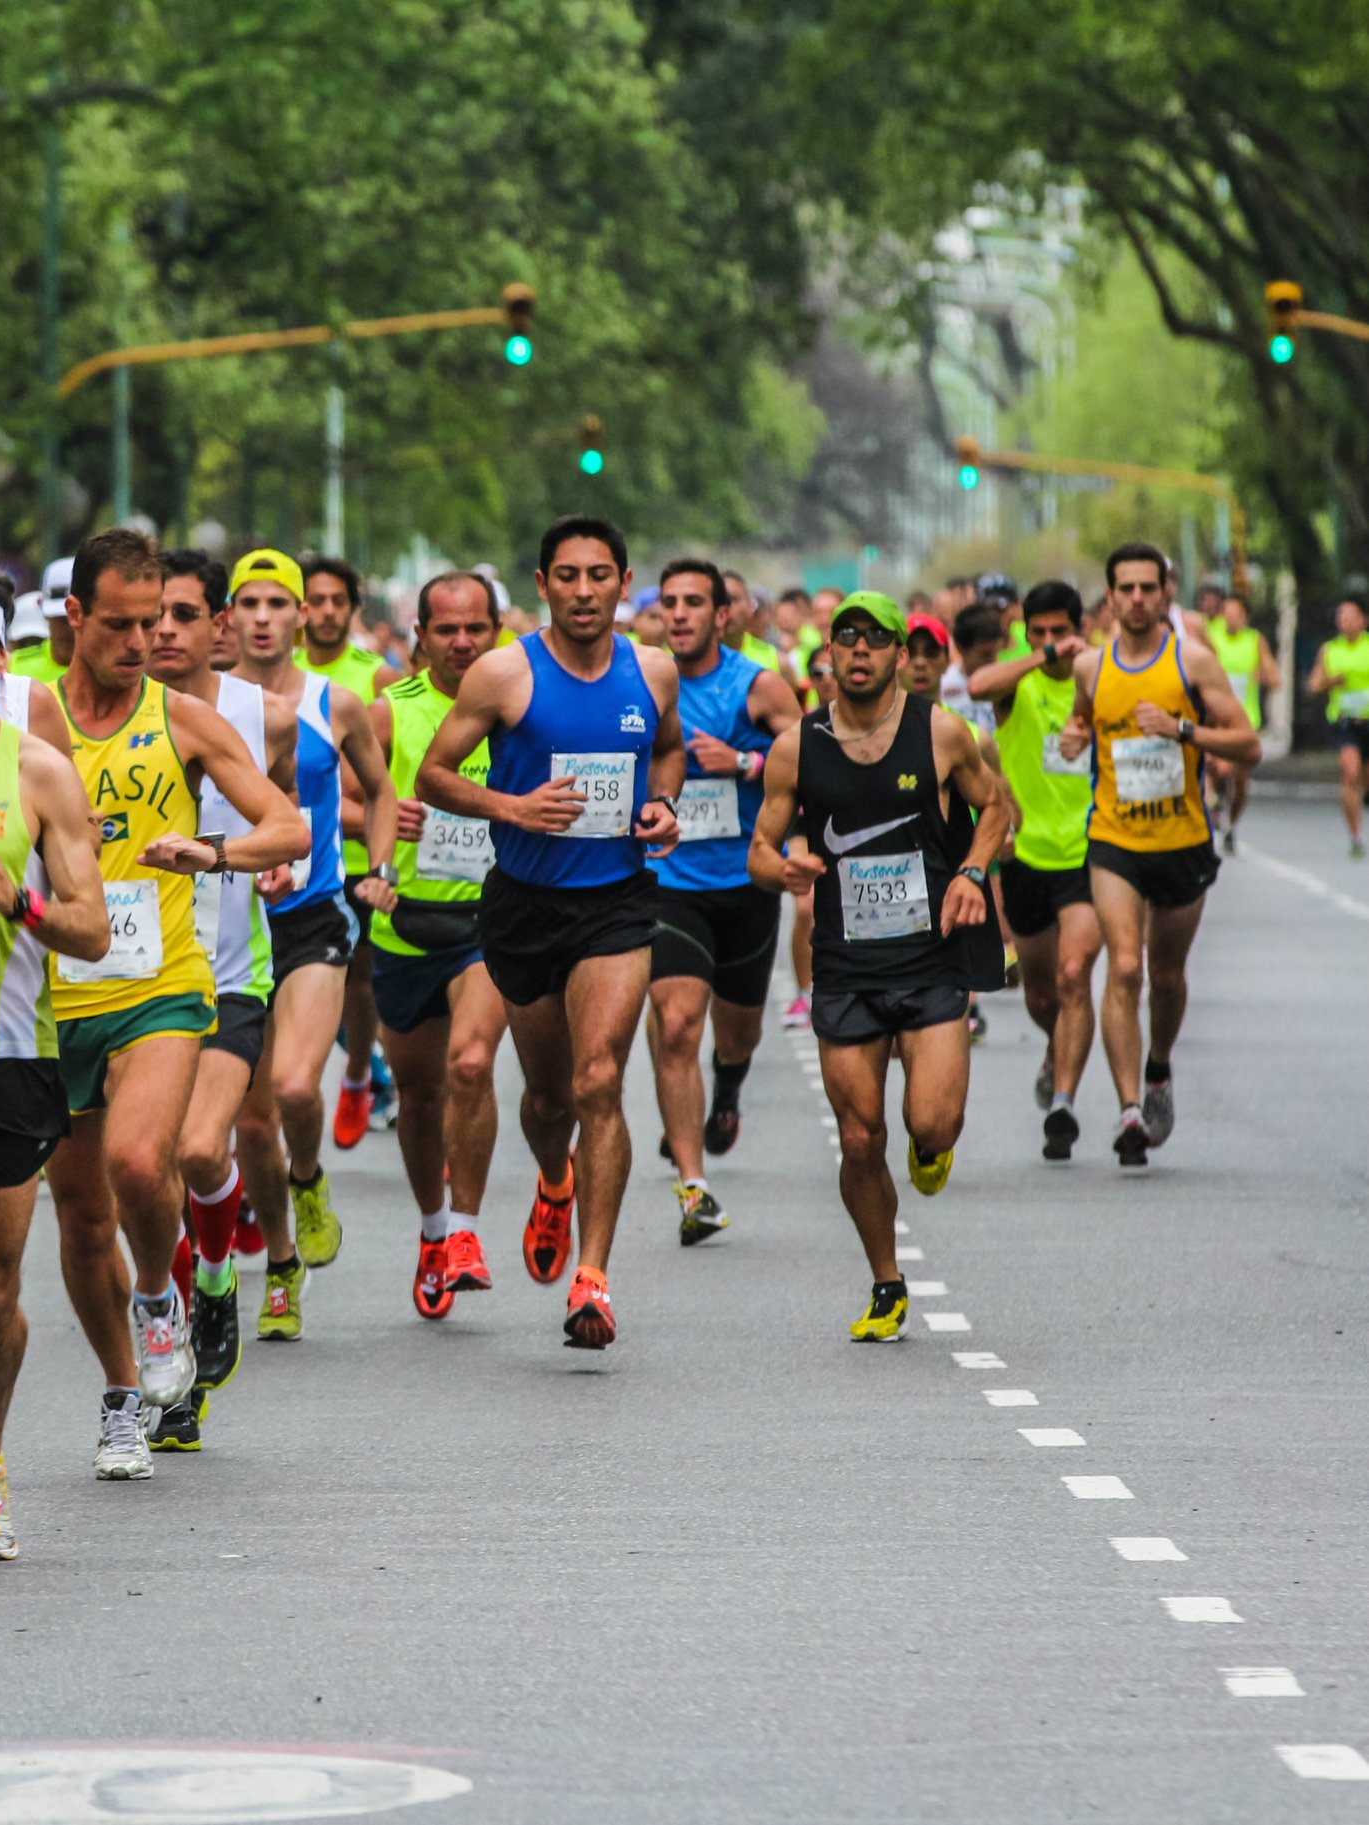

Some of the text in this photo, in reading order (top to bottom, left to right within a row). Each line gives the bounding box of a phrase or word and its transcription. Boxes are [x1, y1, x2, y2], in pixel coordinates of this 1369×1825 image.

[565, 757, 627, 776] Personal
[96, 764, 176, 821] ASIL
[571, 780, 620, 801] 158
[434, 825, 487, 848] 3459
[850, 859, 911, 880] Personal
[854, 880, 907, 904] 7533
[110, 912, 137, 937] 46
